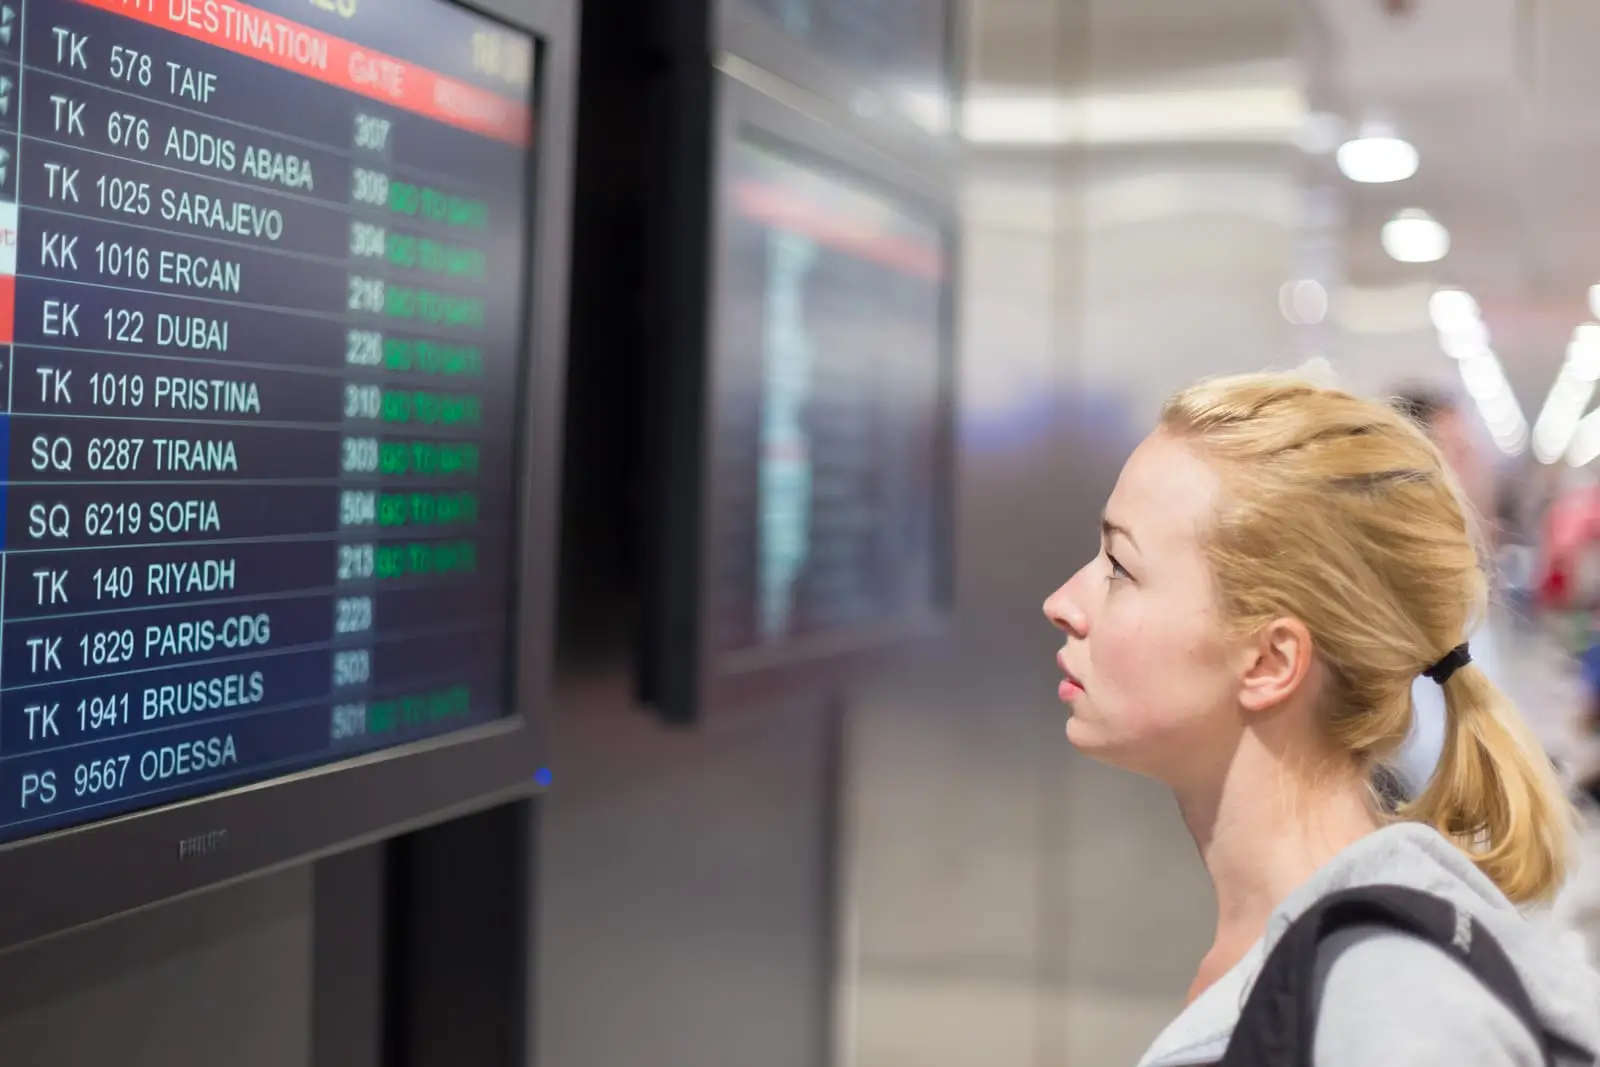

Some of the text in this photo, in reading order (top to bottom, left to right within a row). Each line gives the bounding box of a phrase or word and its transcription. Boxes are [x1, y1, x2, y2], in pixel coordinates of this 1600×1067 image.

[52, 27, 88, 70] TK
[110, 45, 152, 87] 578
[166, 61, 217, 104] TAIF
[168, 0, 328, 71] DESTINATION
[50, 95, 86, 137] TK
[107, 111, 150, 151] 676
[164, 126, 236, 171] ADDIS
[241, 145, 313, 189] ABABA
[43, 163, 80, 203] TK
[96, 175, 151, 215] 1025
[160, 188, 283, 241] SARAJEVO
[41, 231, 78, 270] KK
[95, 241, 150, 280] 1016
[159, 250, 241, 293] ERCAN
[42, 300, 80, 337] EK
[104, 308, 144, 343] 122
[157, 313, 228, 352] DUBAI
[36, 367, 72, 404] TK
[89, 372, 144, 407] 1019
[154, 376, 260, 413] PRISTINA
[31, 436, 72, 471] SQ
[87, 437, 144, 470] 6287
[152, 439, 238, 471] TIRANA
[28, 503, 70, 538] SQ
[85, 502, 141, 536] 6219
[149, 500, 220, 533] SOFIA
[32, 569, 69, 605] TK
[93, 566, 133, 600] 140
[147, 559, 235, 596] RIYADH
[26, 636, 62, 673] TK
[79, 629, 134, 666] 1829
[145, 613, 270, 658] PARIS-CDG
[23, 703, 60, 740] TK
[77, 692, 129, 731] 1941
[142, 671, 264, 721] BRUSSELS
[21, 770, 57, 809] PS
[74, 754, 131, 797] 9567
[139, 735, 237, 782] ODESSA
